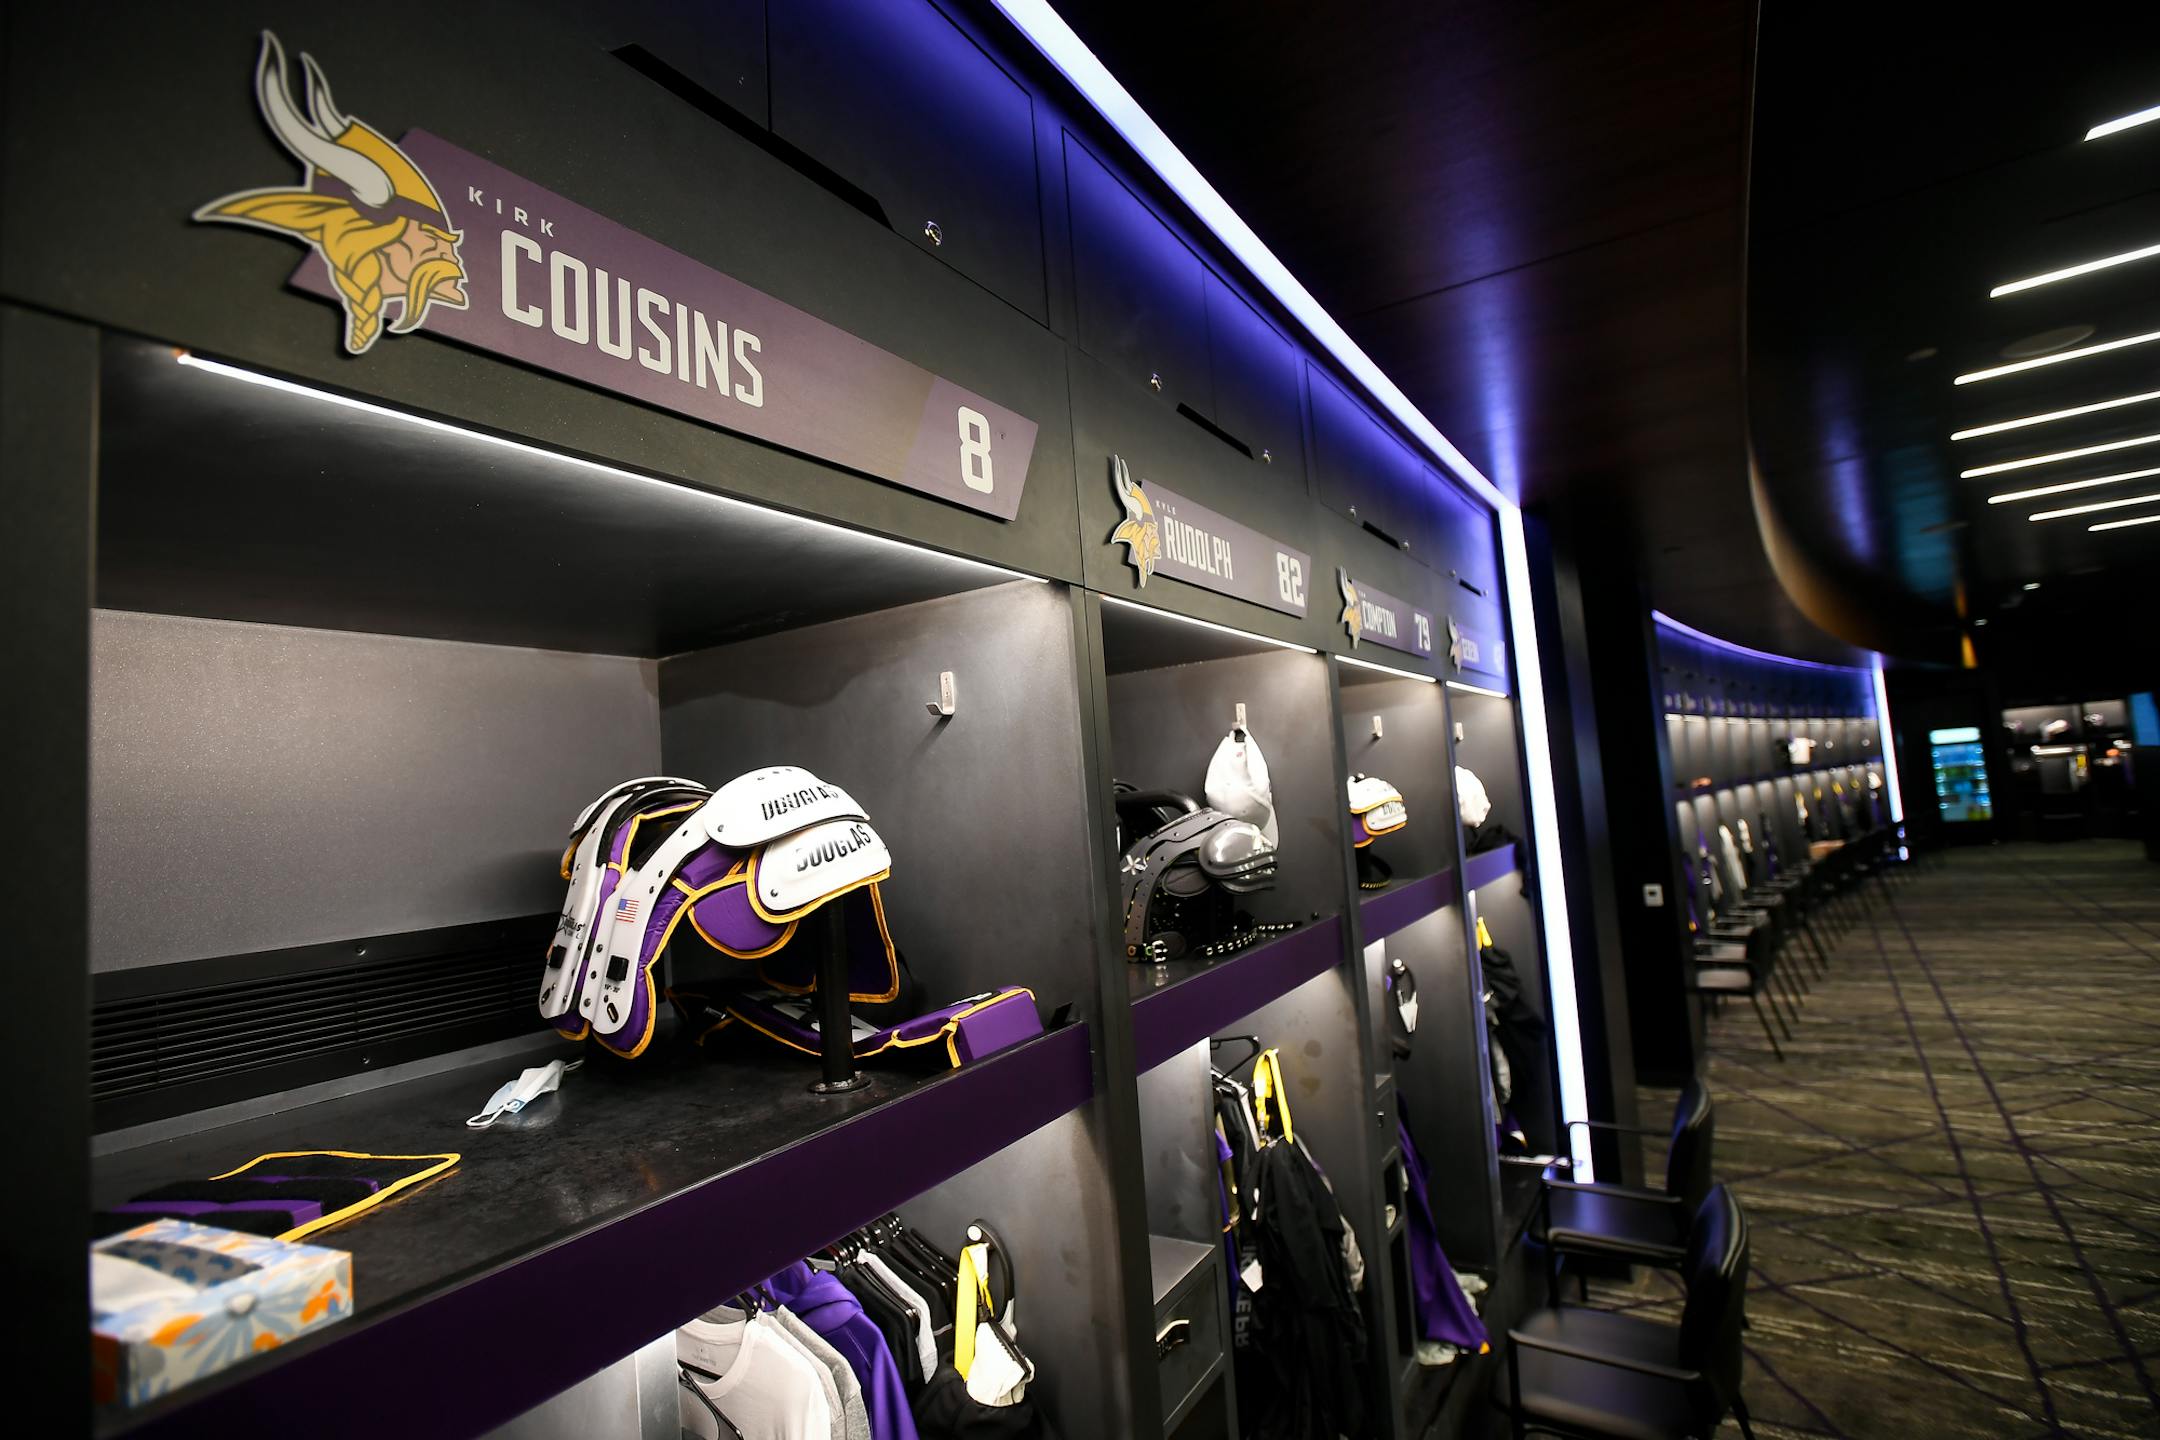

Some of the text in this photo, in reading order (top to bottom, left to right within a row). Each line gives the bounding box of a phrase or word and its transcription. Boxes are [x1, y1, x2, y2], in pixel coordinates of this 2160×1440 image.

[468, 186, 554, 238] KIRK
[501, 229, 764, 408] COUSINS
[957, 405, 994, 494] 8
[1155, 500, 1177, 516] KYLE
[1163, 515, 1234, 581] RUDOLPH
[1276, 551, 1306, 608] 82
[1361, 600, 1398, 640] COMPTON
[1413, 612, 1432, 652] 79
[761, 785, 839, 821] DOUGLAS
[795, 824, 871, 872] DOUGLAS
